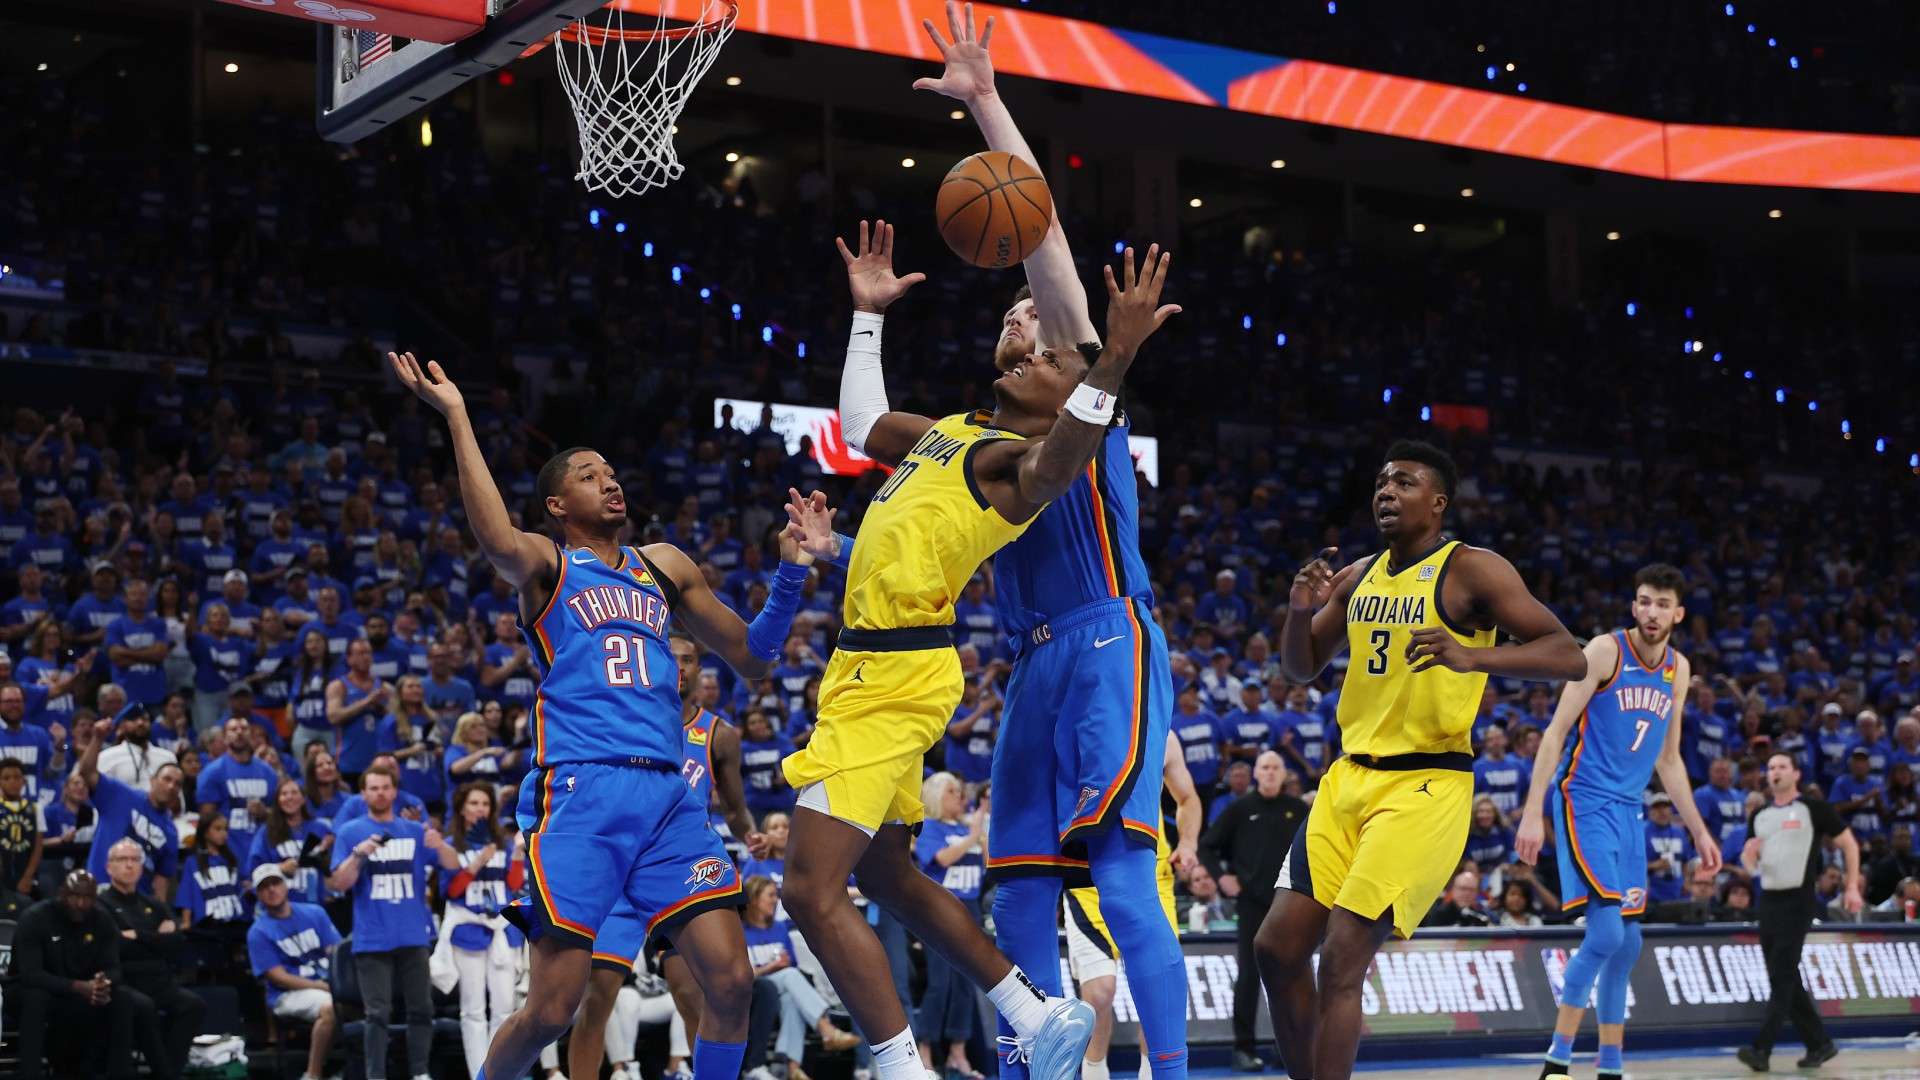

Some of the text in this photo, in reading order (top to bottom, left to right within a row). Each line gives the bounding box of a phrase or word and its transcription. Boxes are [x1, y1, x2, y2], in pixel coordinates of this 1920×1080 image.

[568, 586, 669, 634] THUNDER
[1347, 595, 1425, 624] INDIANA
[604, 634, 652, 688] 21
[1367, 628, 1391, 676] 3
[1615, 686, 1672, 721] THUNDER
[1628, 719, 1650, 752] 7
[1375, 950, 1524, 1014] MOMENT
[1653, 944, 1772, 1005] FOLLOW
